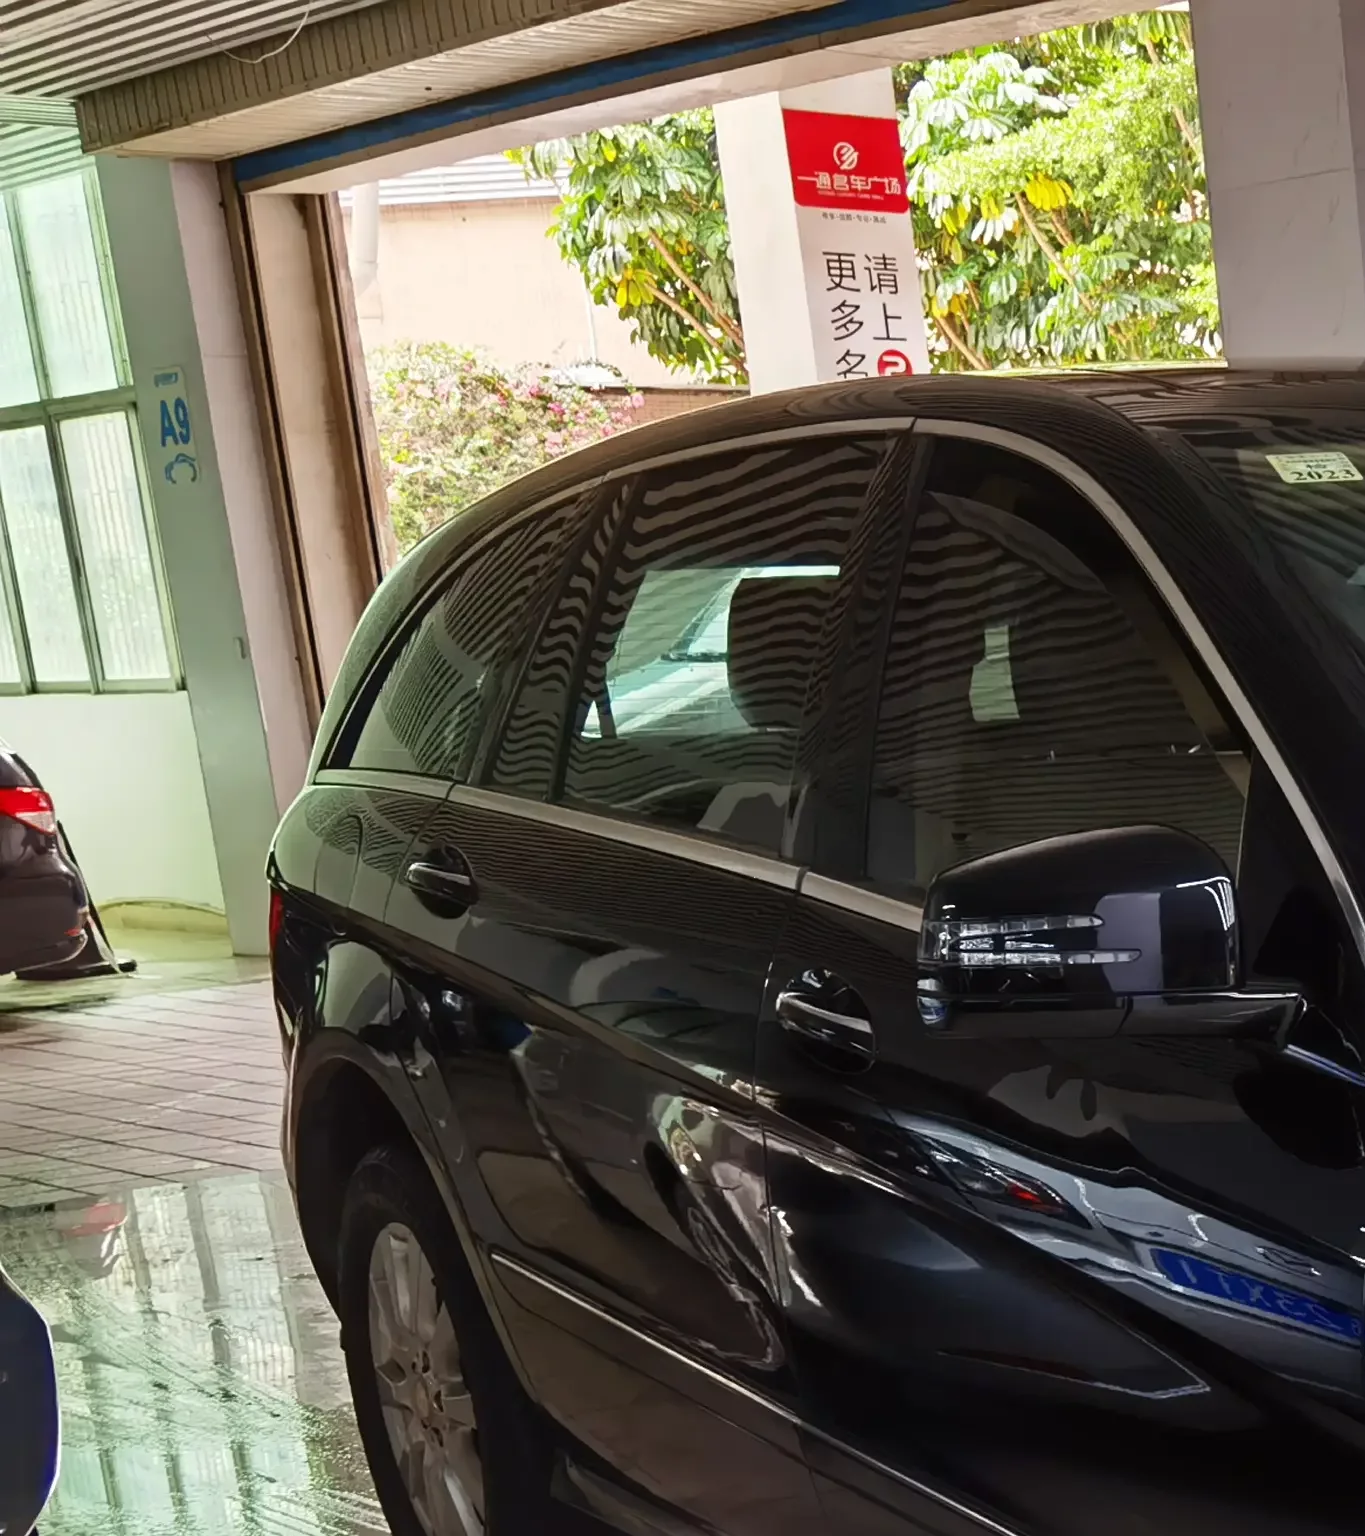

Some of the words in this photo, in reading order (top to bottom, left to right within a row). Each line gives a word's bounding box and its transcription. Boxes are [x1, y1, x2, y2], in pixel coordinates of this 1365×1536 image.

[823, 251, 868, 379] 更多名
[1289, 468, 1356, 482] 2023
